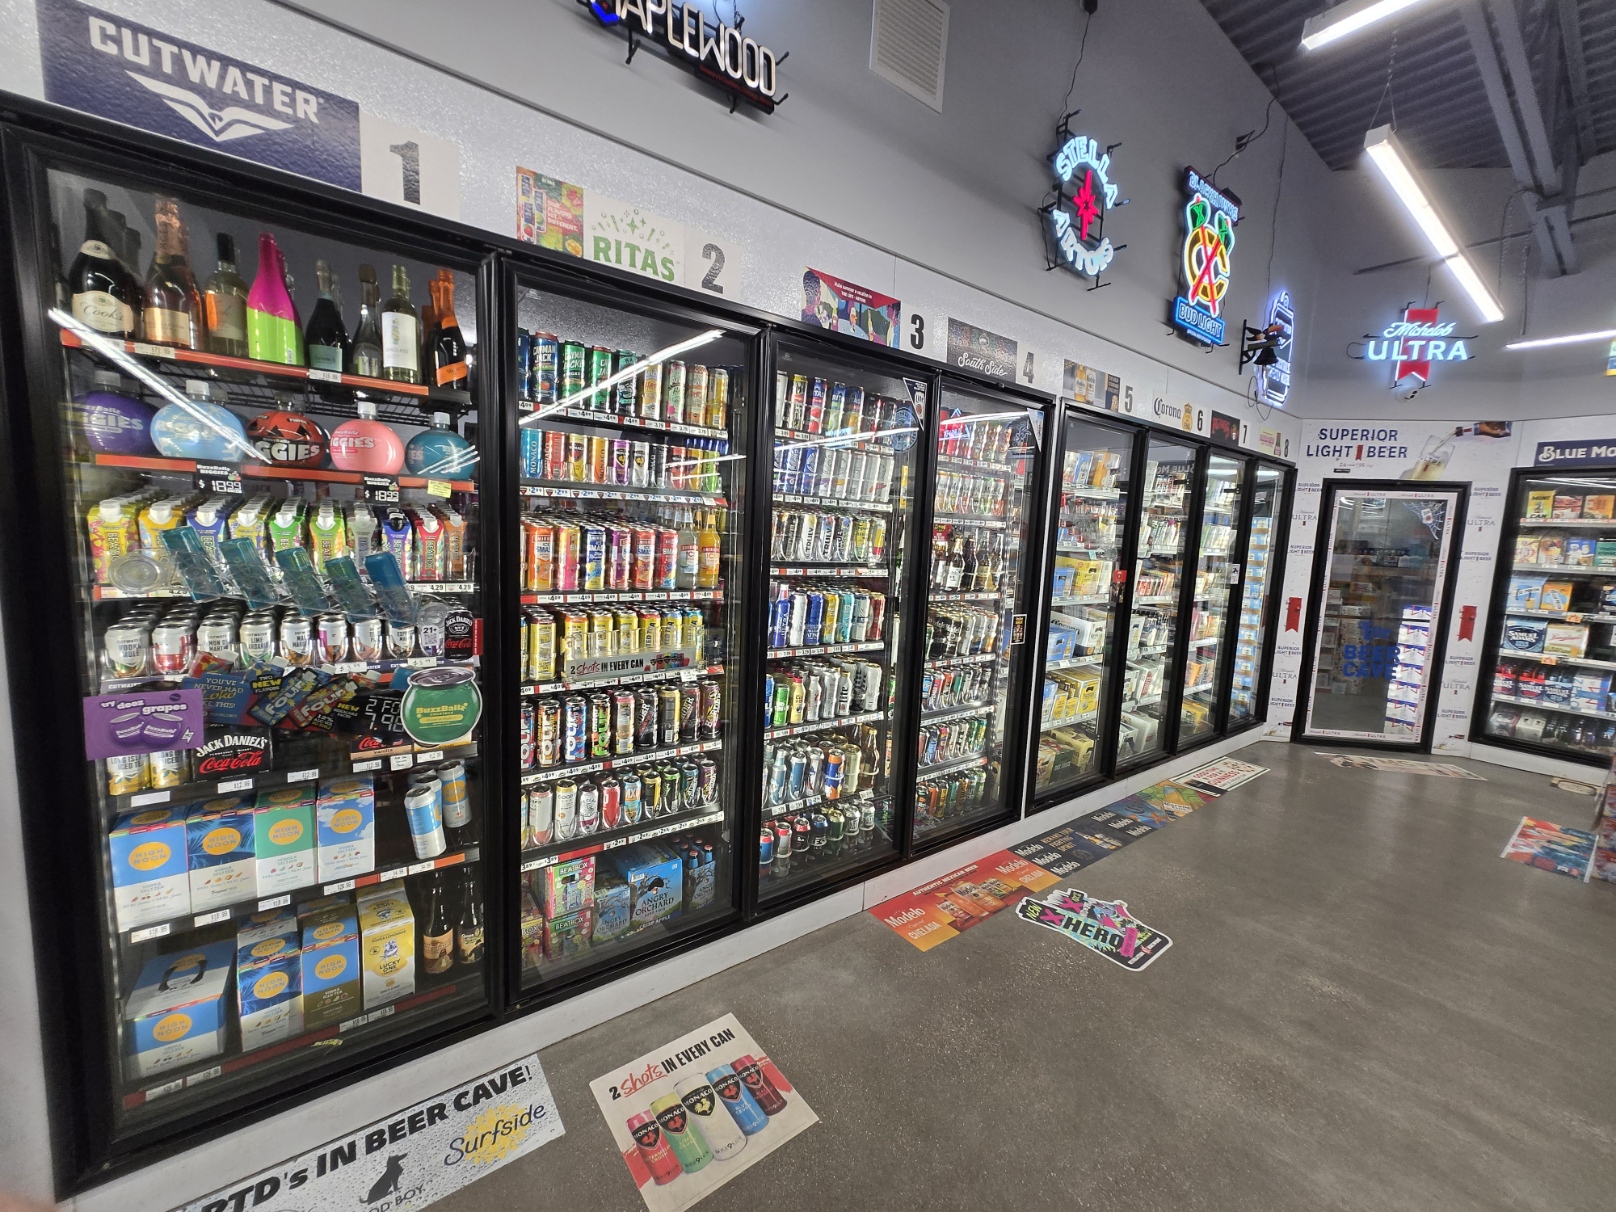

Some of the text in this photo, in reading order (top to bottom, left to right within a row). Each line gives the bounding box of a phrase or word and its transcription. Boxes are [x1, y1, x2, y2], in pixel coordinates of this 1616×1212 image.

[88, 16, 320, 124] CUTWATER
[390, 140, 421, 205] 1
[1055, 135, 1119, 210] STELLA
[1052, 208, 1115, 277] ARTOIS
[592, 235, 676, 282] RITAS
[701, 243, 726, 294] 2
[83, 303, 124, 322] Cook's
[1178, 302, 1197, 326] BUD
[1198, 312, 1223, 338] LIGHT
[910, 313, 925, 350] 3
[1383, 321, 1457, 339] Michelob
[533, 345, 556, 356] CAYMAN
[535, 353, 552, 364] JACK
[1367, 340, 1469, 361] ULTRA
[957, 352, 1008, 377] South Side
[1023, 351, 1035, 384] 4
[1125, 385, 1134, 413] 5
[1154, 397, 1181, 419] Corona
[1197, 409, 1204, 432] 6
[1243, 424, 1248, 444] 7
[1319, 428, 1398, 442] SUPERIOR
[1284, 438, 1290, 458] 8
[1306, 444, 1408, 459] LIGHT BEER
[1539, 445, 1588, 462] BLUE
[529, 440, 538, 474] MONACO
[199, 479, 206, 489] $
[365, 490, 370, 498] $
[1292, 513, 1317, 521] ULTRA
[805, 526, 815, 553] TRULY
[822, 527, 832, 556] TRULY
[423, 626, 437, 634] 21+
[1508, 629, 1538, 640] SAMUEL
[1343, 645, 1401, 663] BEER
[570, 665, 576, 675] 2
[601, 662, 609, 672] IN
[609, 659, 630, 672] EVERY
[630, 658, 644, 668] CAN
[1343, 663, 1398, 681] CAVE
[194, 683, 243, 694] NEVER HAD
[206, 677, 237, 686] YOU'VE
[252, 678, 282, 689] NEW
[1443, 682, 1471, 691] ULTRA
[101, 699, 188, 716] try deez grapes
[215, 701, 236, 709] THIS!
[337, 702, 360, 712] NEW
[365, 698, 402, 715] 2 FO
[196, 734, 268, 758] JACK DANIEL'S
[333, 818, 360, 829] NOON
[335, 813, 357, 823] HIGH
[1091, 811, 1116, 823] Modelo
[1108, 818, 1134, 829] Modelo
[272, 829, 301, 840] NOON
[274, 823, 299, 834] HIGH
[1125, 825, 1152, 837] Modelo
[207, 838, 239, 850] NOON
[208, 832, 235, 844] HIGH
[135, 847, 164, 859] HIGH
[1014, 842, 1044, 858] Modelo
[134, 855, 168, 866] NOON
[1032, 851, 1062, 866] Modelo
[559, 861, 589, 875] BEATBOX
[995, 859, 1029, 875] Modelo
[1050, 860, 1081, 876] Modelo
[912, 879, 943, 896] AUTHENTIC
[943, 869, 968, 887] MEXICAN
[1018, 869, 1046, 884] CHELADA
[635, 896, 674, 917] ORCHARD
[641, 890, 669, 907] ANGRY
[654, 914, 671, 925] APPLE
[884, 906, 926, 928] Modelo
[1026, 901, 1043, 922] NEW
[555, 916, 585, 931] BEATBOX
[596, 918, 628, 933] ORCHARD
[600, 915, 622, 926] ANGRY
[907, 921, 943, 941] CHELADA
[1061, 915, 1127, 951] HERO
[318, 963, 344, 975] NOON
[320, 959, 343, 971] HIGH
[379, 957, 401, 971] LUCKY
[382, 964, 398, 974] ONE
[257, 981, 286, 995] NOON
[259, 976, 284, 988] HIGH
[157, 1023, 188, 1037] NOON
[159, 1018, 186, 1032] HIGH
[608, 1085, 622, 1101] 2
[660, 1057, 678, 1074] IN
[677, 1037, 712, 1067] EVERY
[709, 1027, 736, 1049] CAN
[317, 1143, 359, 1178] IN
[365, 1101, 448, 1156] BEER
[453, 1064, 533, 1113] CAVE!
[443, 1103, 546, 1168] Surfside
[395, 1184, 424, 1206] BOY
